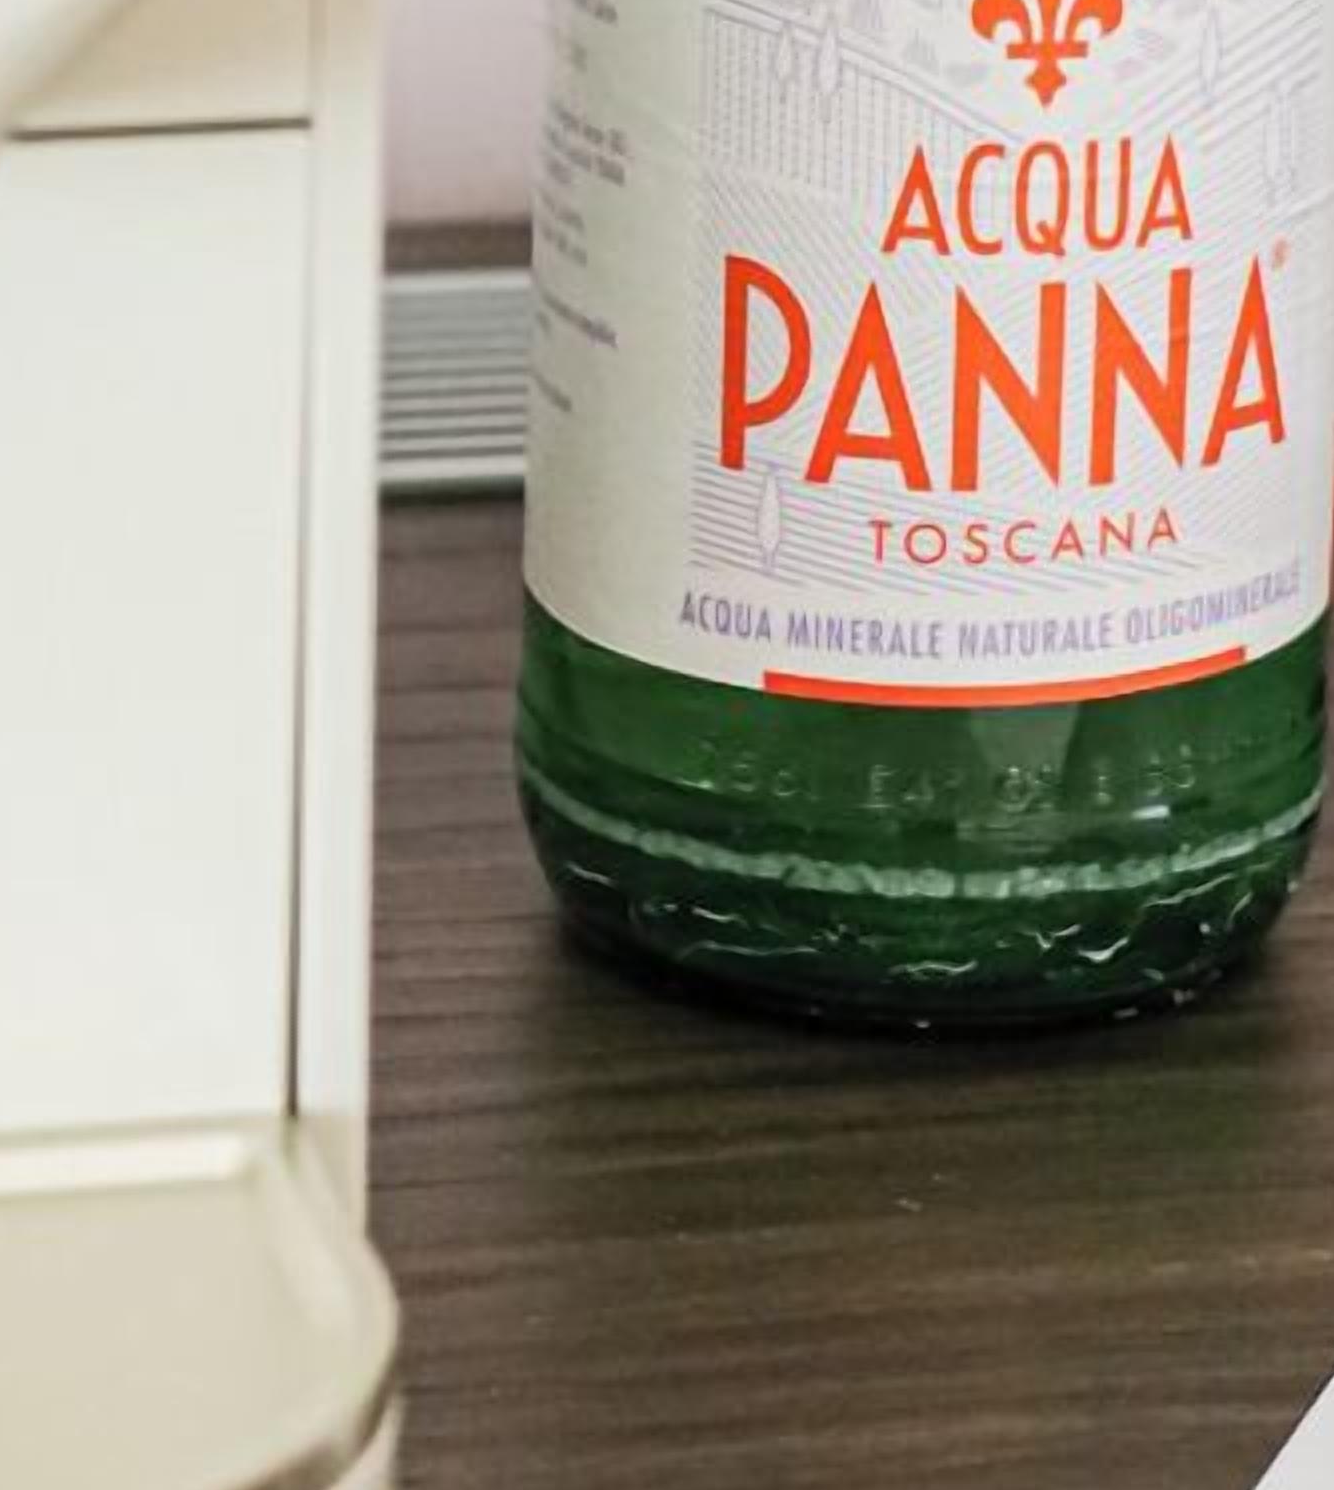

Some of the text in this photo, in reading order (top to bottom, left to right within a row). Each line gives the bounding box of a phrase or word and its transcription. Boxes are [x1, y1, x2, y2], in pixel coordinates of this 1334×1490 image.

[880, 132, 1195, 258] ACQUA
[719, 250, 1289, 494] PANNA
[867, 506, 1179, 566] TOSCANA
[679, 588, 772, 644] ACQUA
[784, 612, 943, 661] MINERALE
[957, 610, 1113, 662] NATURALE
